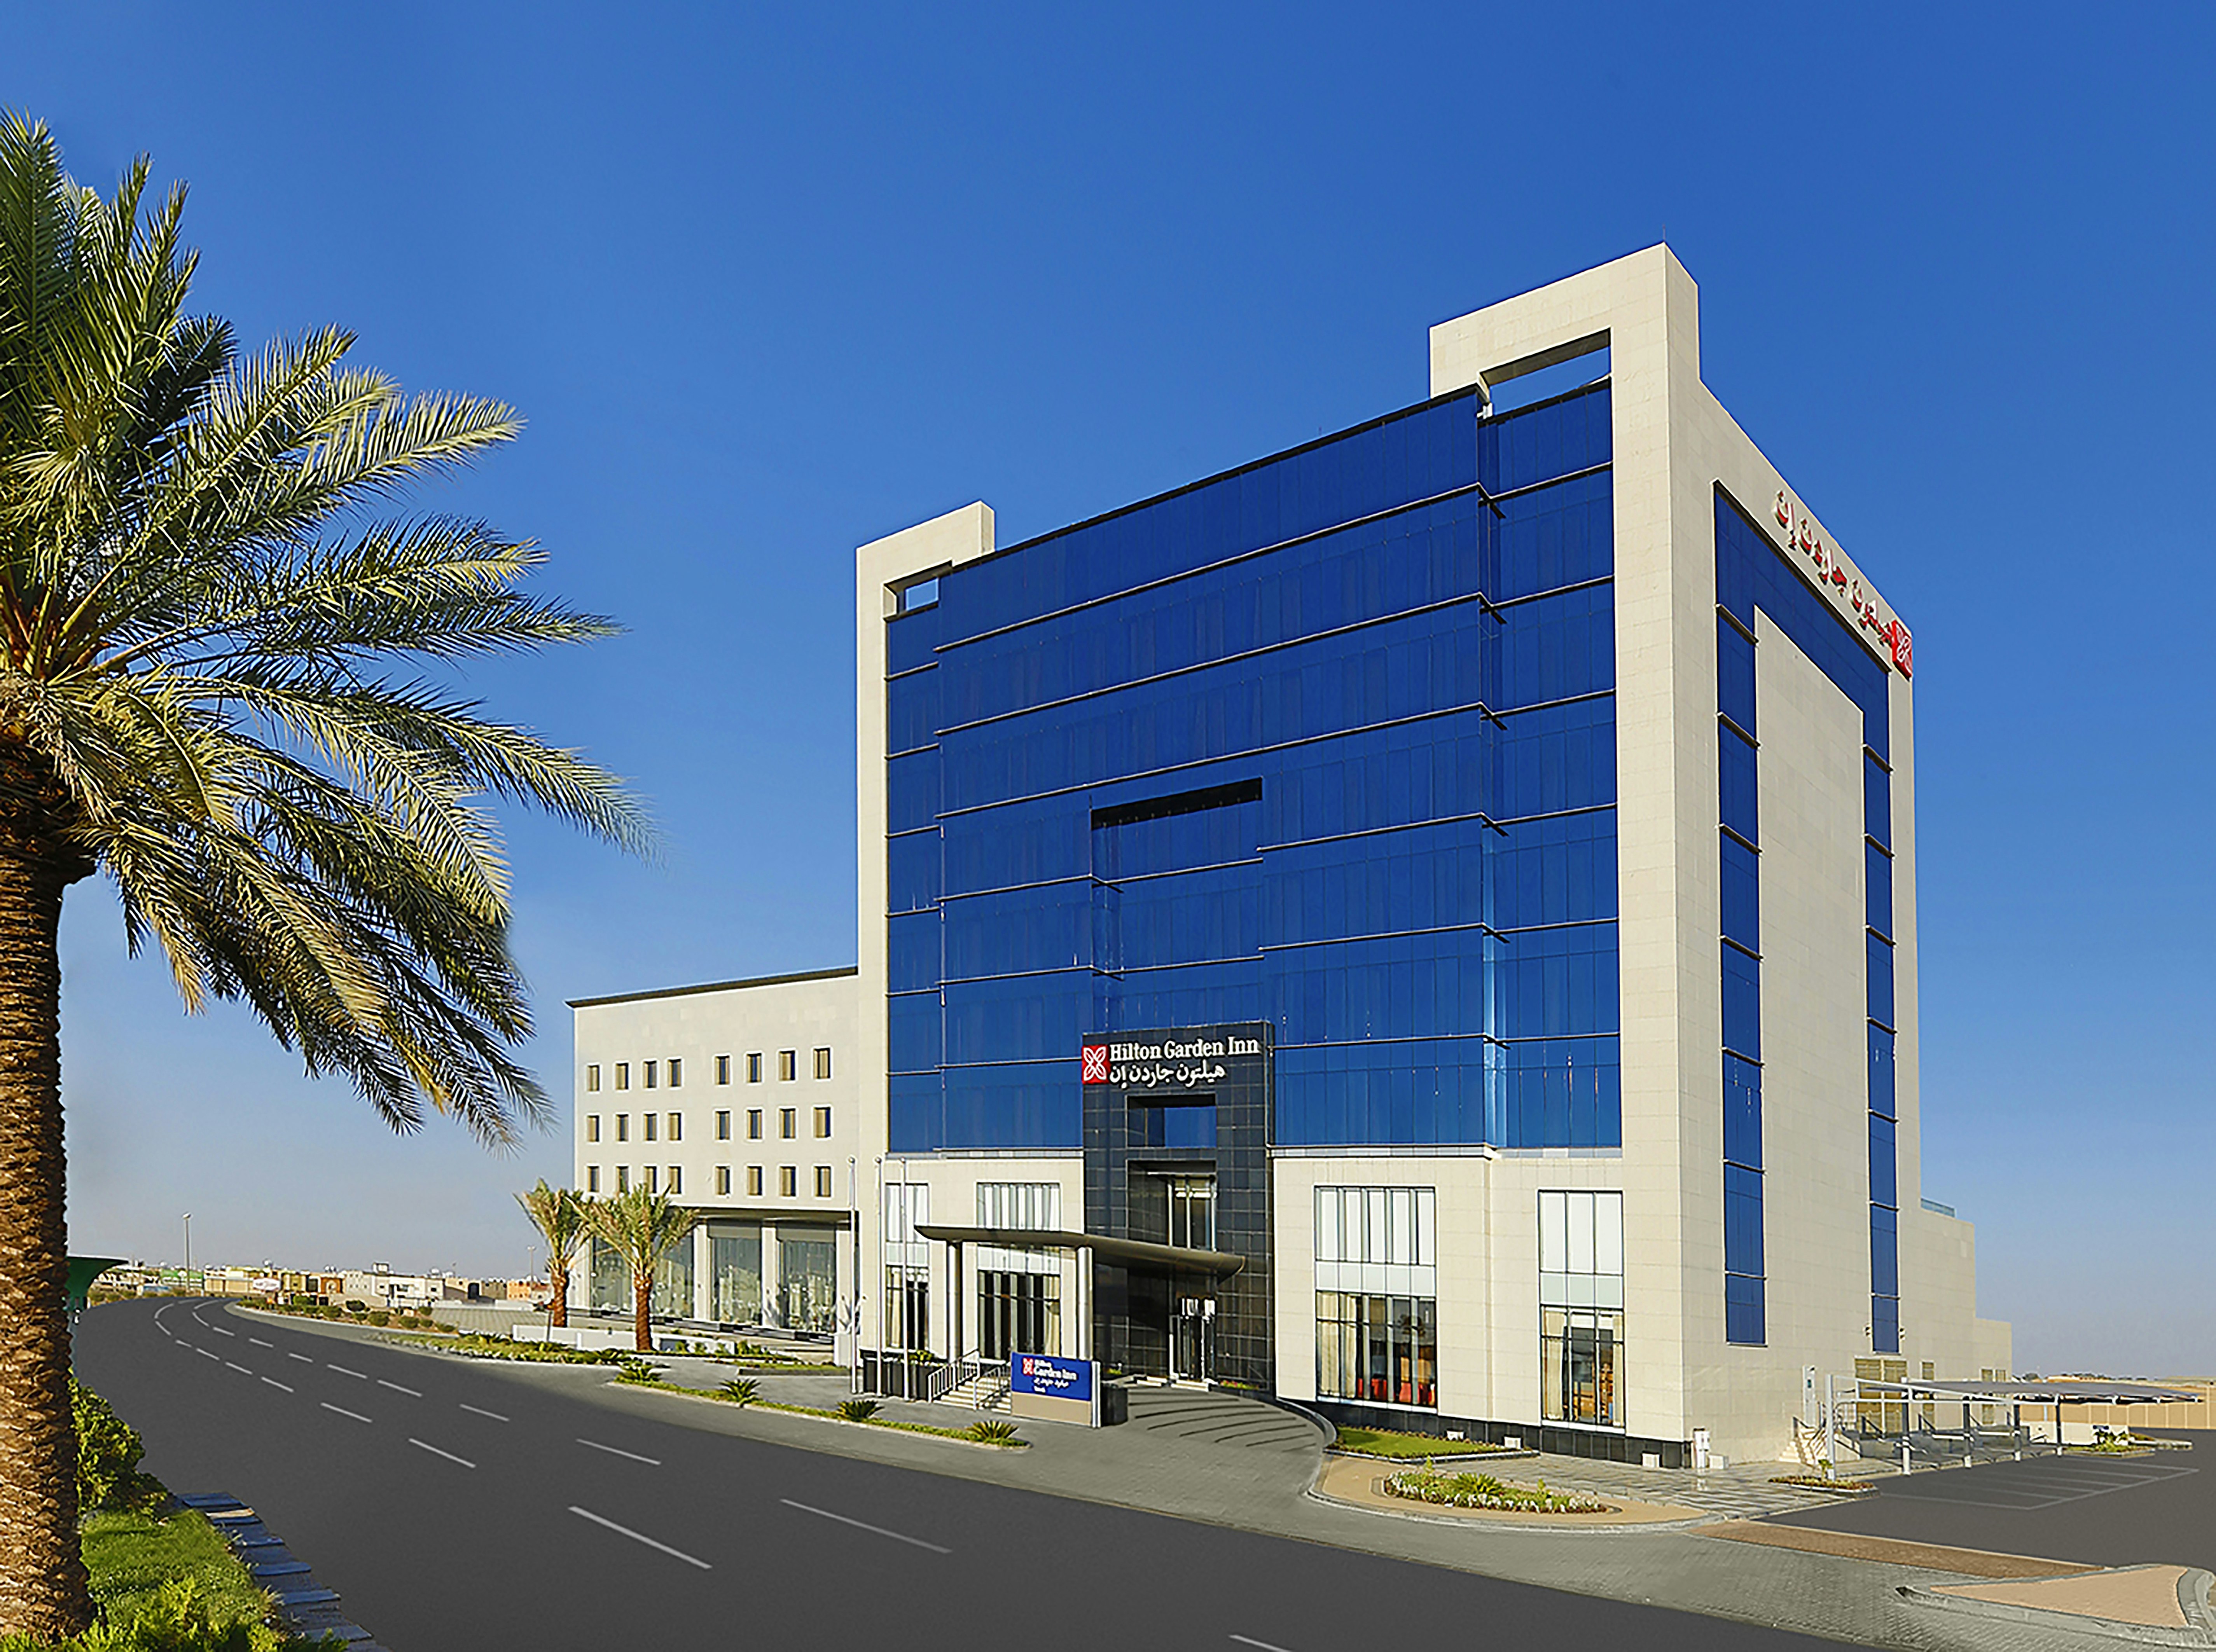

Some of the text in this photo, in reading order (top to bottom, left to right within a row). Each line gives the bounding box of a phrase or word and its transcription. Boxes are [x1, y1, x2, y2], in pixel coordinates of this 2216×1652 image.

[1110, 1036, 1260, 1062] Hilton Garden Inn
[1109, 1059, 1226, 1089] هيلتون جاردن إن
